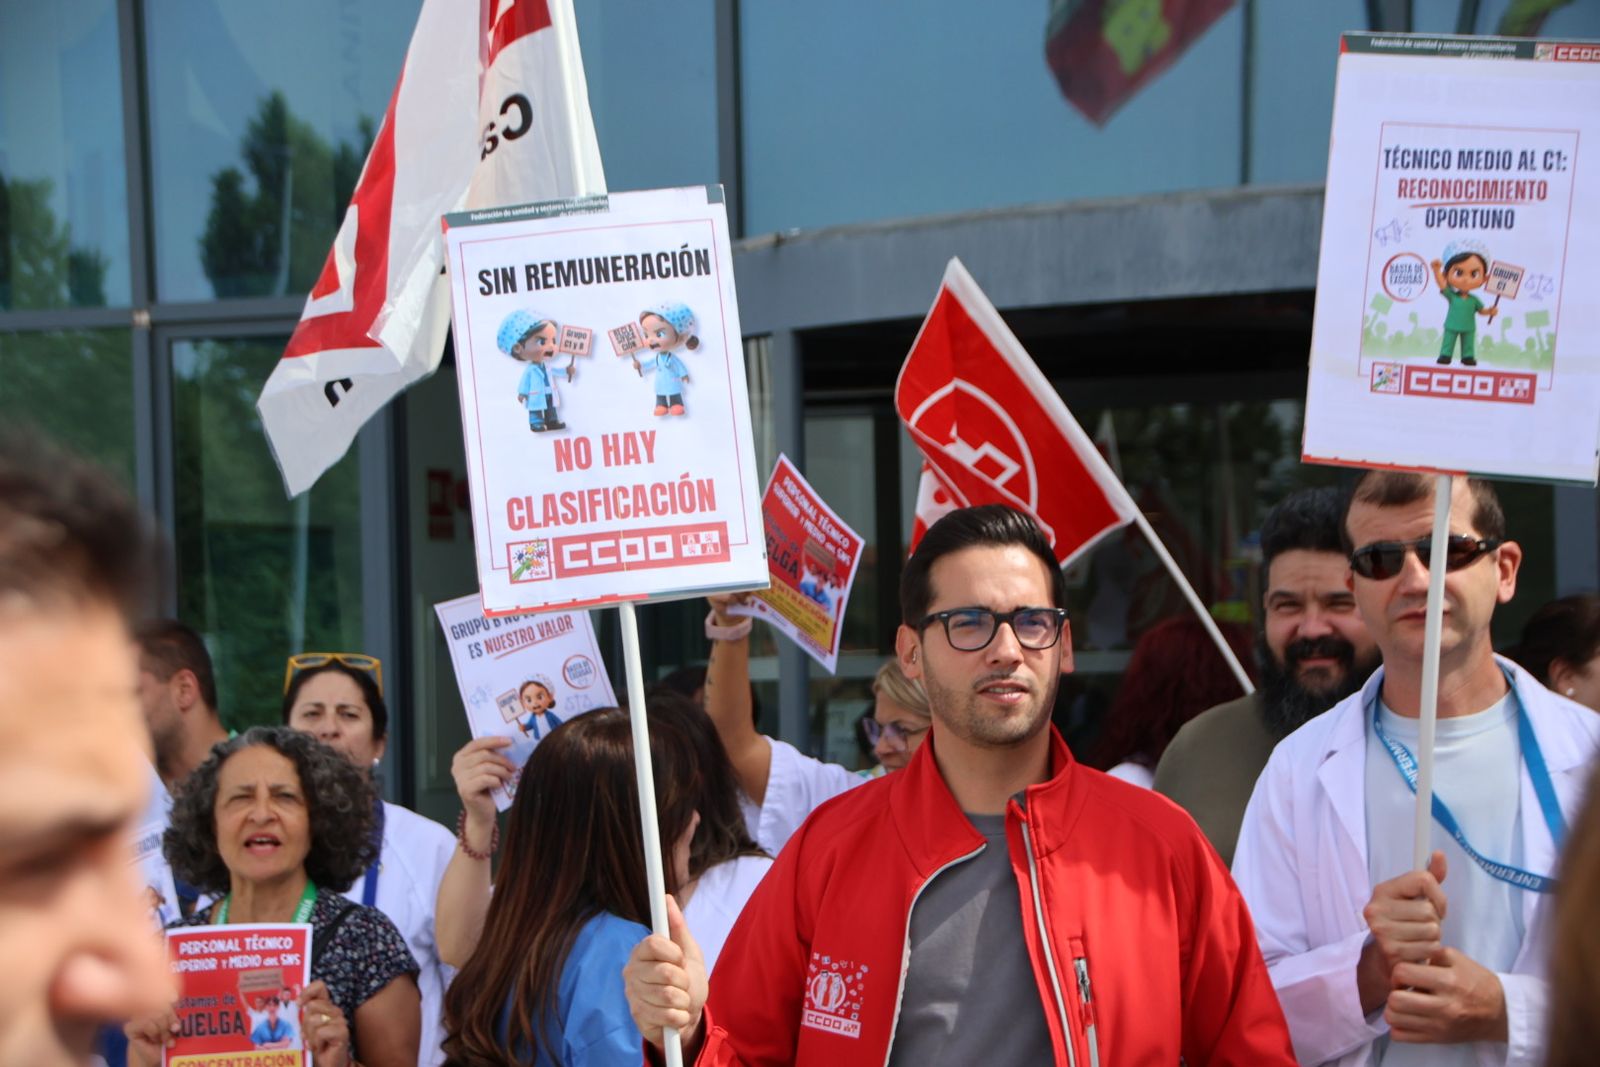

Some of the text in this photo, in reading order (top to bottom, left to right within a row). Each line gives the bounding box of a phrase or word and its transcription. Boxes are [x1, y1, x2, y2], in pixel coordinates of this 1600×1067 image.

[1384, 144, 1567, 172] TÉCNICO MEDIO AL C1:
[1398, 178, 1548, 201] RECONOCIMIENTO
[1425, 207, 1515, 230] OPORTUNO
[478, 243, 711, 296] SIN REMUNERACIÓN
[1494, 267, 1519, 281] GRUPO
[1410, 370, 1494, 396] CCOO
[554, 430, 656, 472] NO HAY
[506, 472, 717, 531] CLASIFICACIÓN
[562, 534, 674, 569] CCOO
[451, 614, 490, 640] GRUPO
[468, 641, 483, 659] ES
[484, 626, 535, 655] NUESTRO
[537, 614, 574, 639] VALOR
[179, 934, 293, 955] PERSONAL TÉCNICO
[229, 954, 261, 969] MEDIO
[280, 953, 300, 966] SNS
[176, 995, 217, 1009] stamos
[176, 1010, 246, 1038] UELGA
[807, 1013, 842, 1030] CCOO
